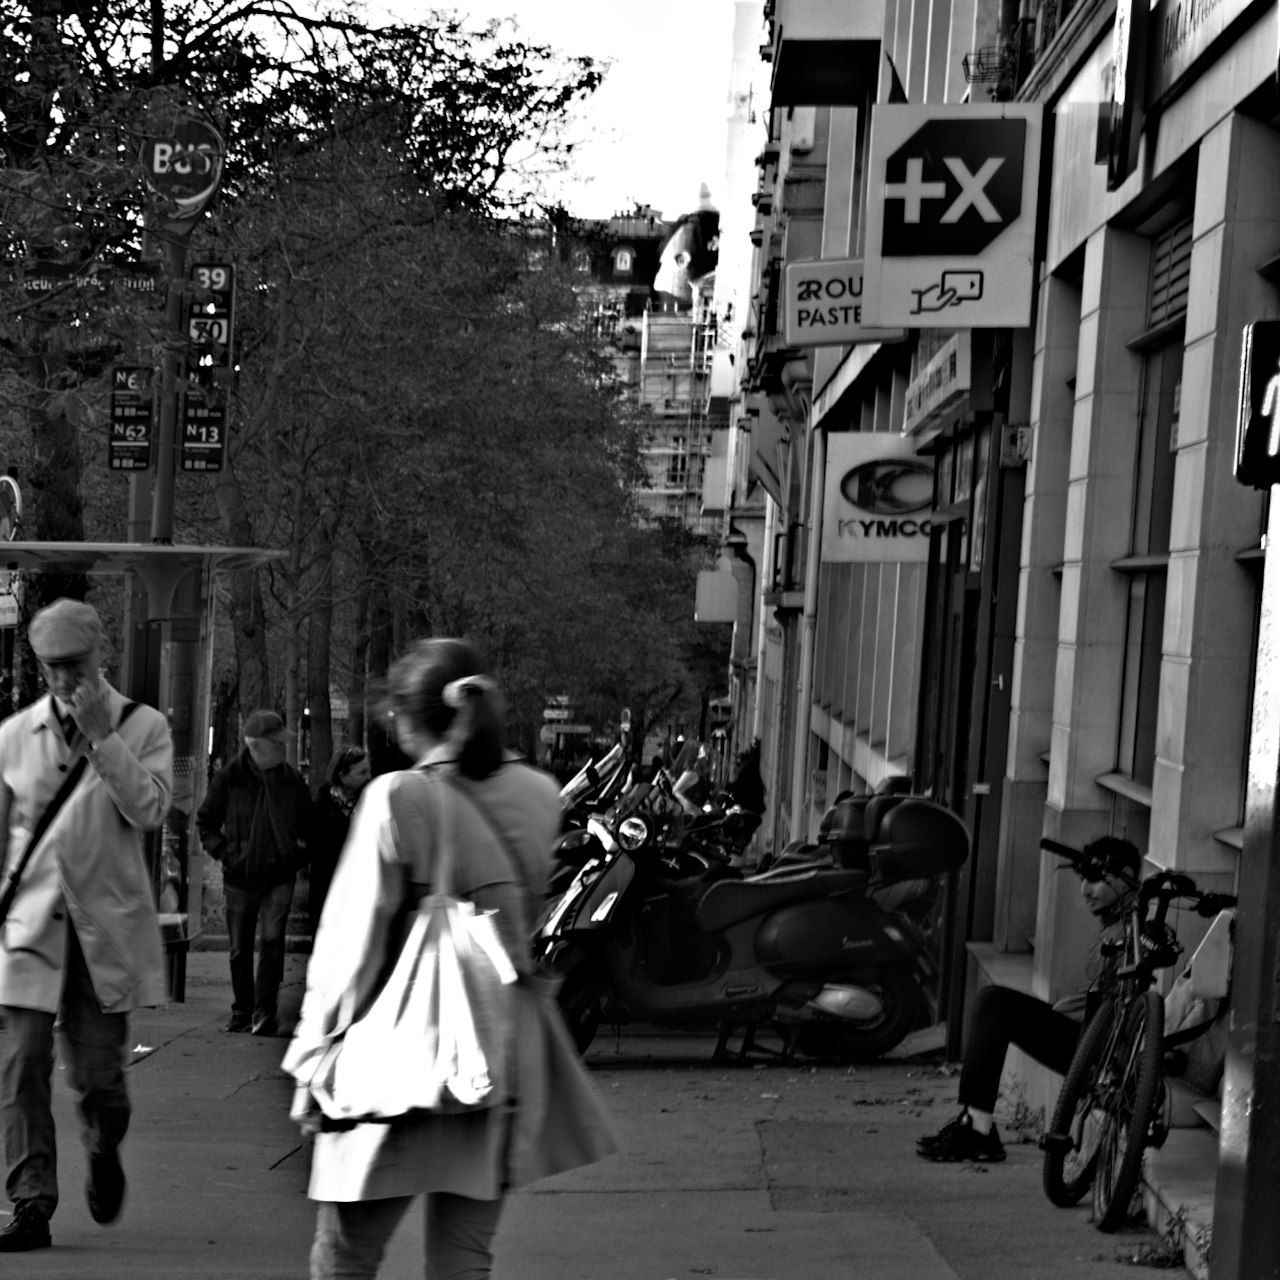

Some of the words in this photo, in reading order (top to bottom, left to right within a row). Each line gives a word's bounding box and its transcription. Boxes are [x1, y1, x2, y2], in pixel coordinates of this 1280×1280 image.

[153, 143, 211, 175] BUS
[197, 268, 226, 290] 39
[114, 423, 146, 441] N62
[187, 423, 219, 442] N13
